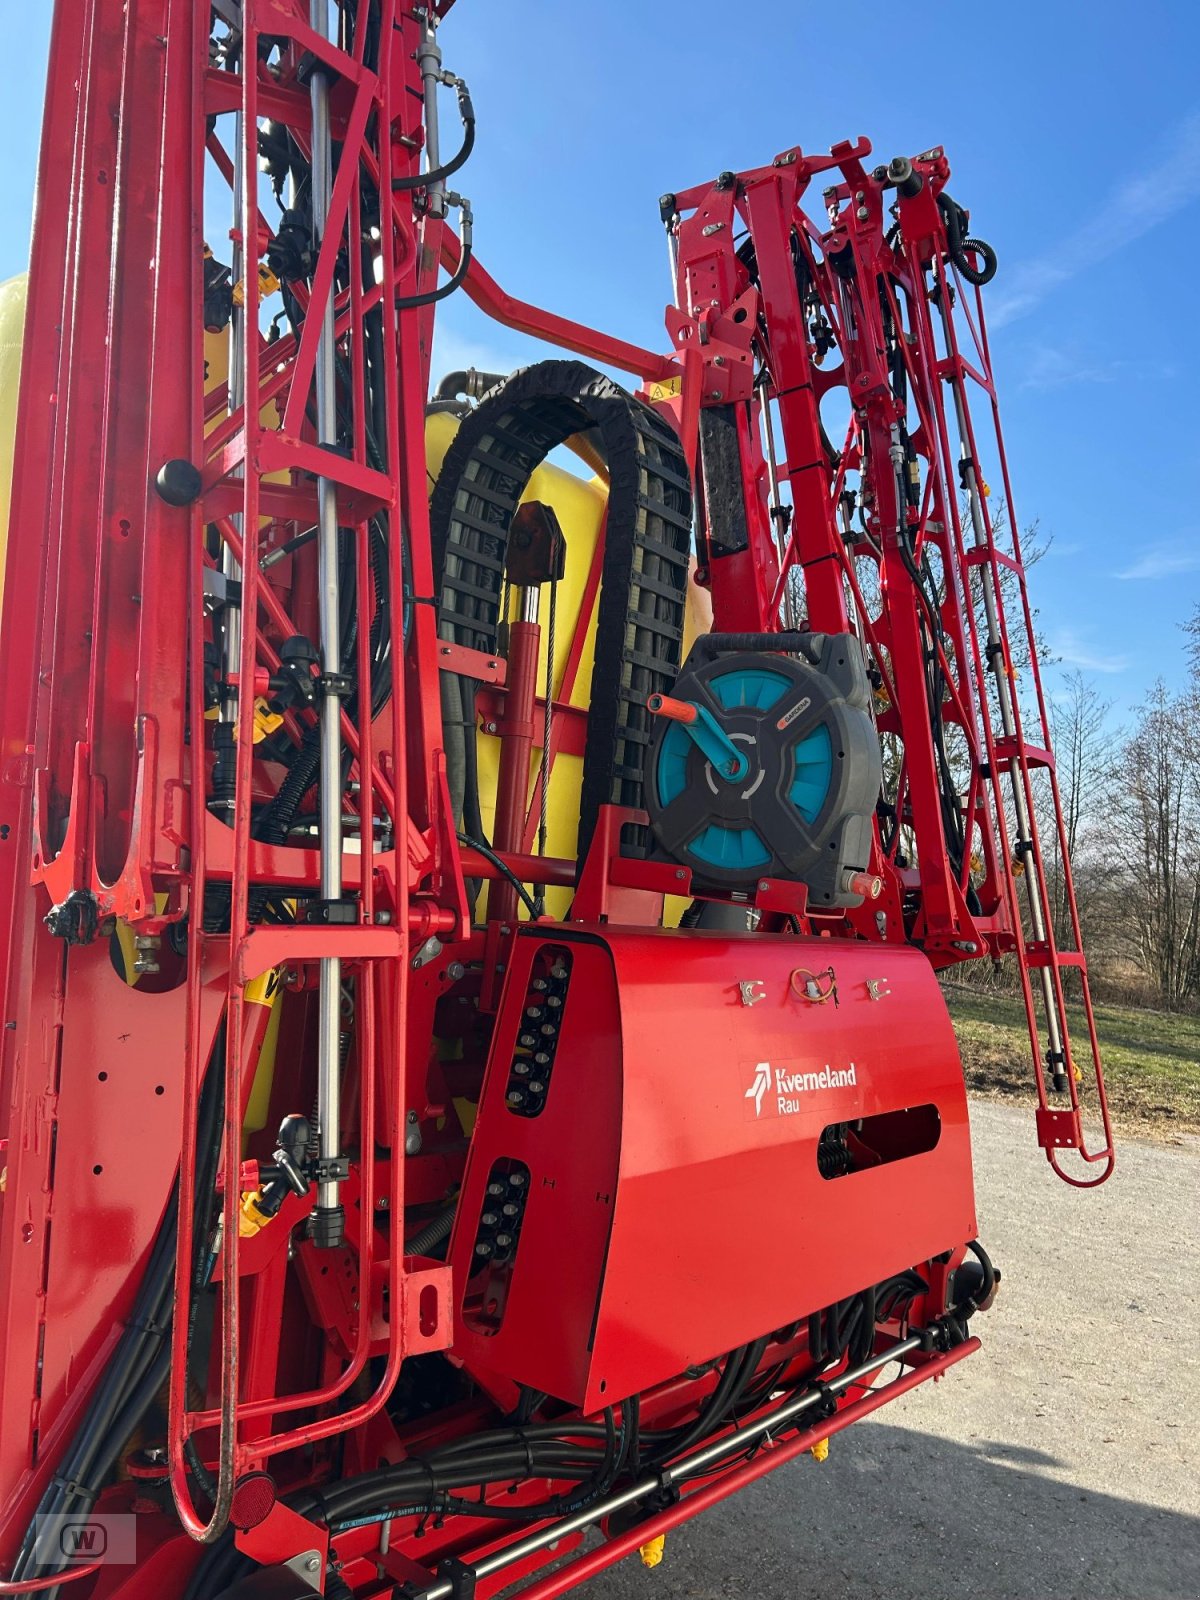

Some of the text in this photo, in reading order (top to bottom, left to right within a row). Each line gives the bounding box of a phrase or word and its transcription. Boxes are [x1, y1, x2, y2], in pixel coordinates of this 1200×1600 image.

[784, 699, 809, 723] GARDENA
[775, 1062, 857, 1095] Kverneland
[777, 1096, 800, 1115] Rau
